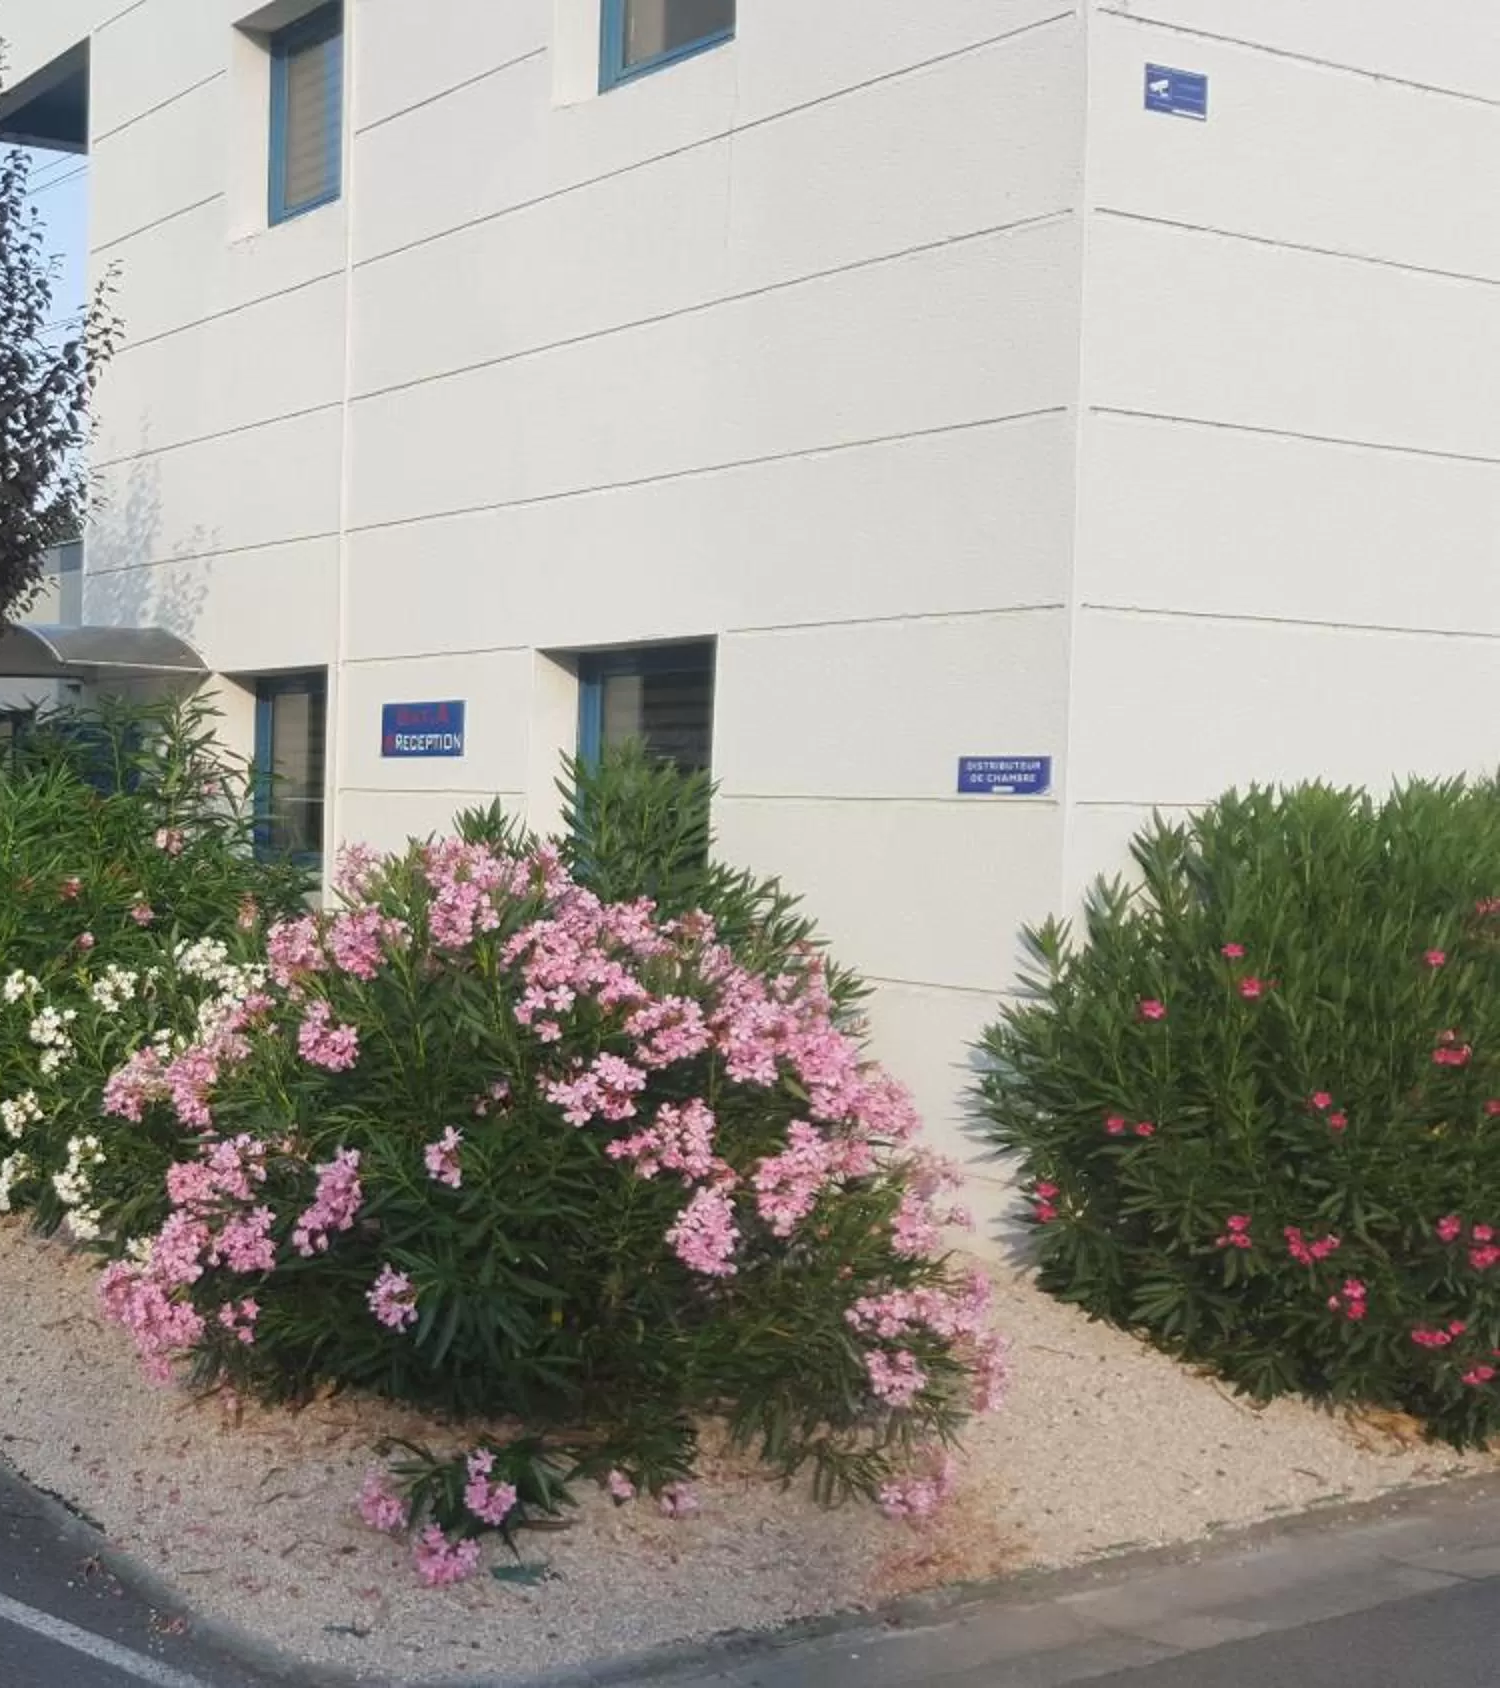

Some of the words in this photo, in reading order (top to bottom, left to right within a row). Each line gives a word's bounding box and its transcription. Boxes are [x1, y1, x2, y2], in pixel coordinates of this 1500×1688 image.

[395, 732, 461, 750] RECEPTION
[966, 760, 1041, 771] DISTRIBUTEUR
[969, 773, 983, 783] DE
[987, 773, 1036, 783] CHAMBRE
